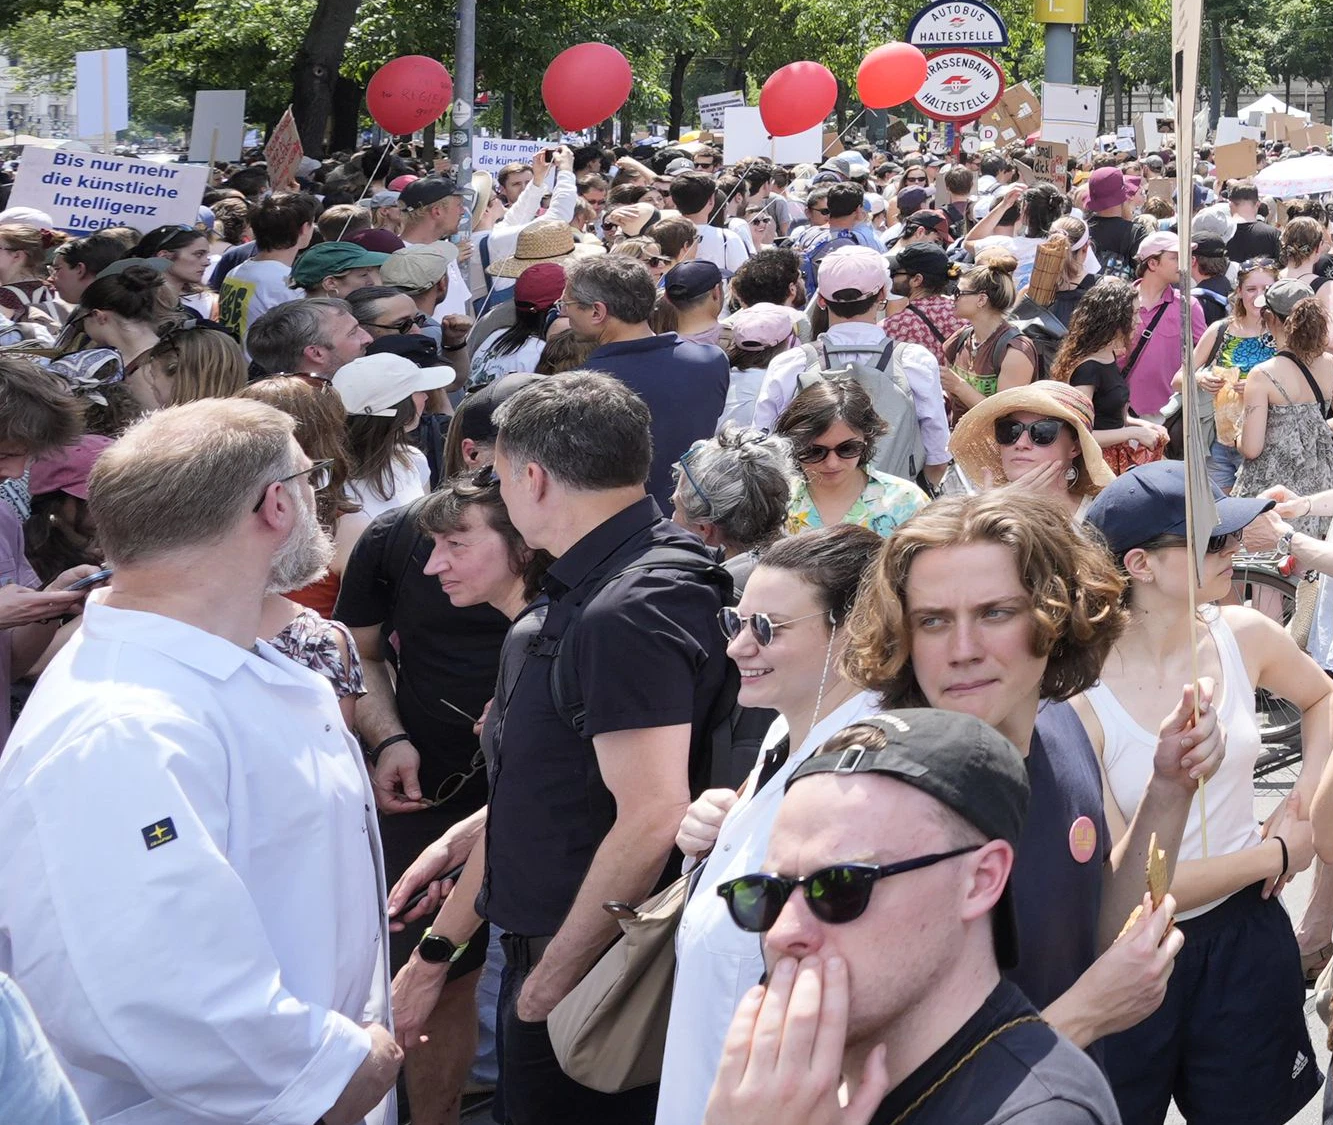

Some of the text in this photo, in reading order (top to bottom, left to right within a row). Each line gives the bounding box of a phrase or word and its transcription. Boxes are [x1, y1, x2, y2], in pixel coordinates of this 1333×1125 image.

[931, 5, 986, 22] AUTOBUS
[920, 31, 994, 42] HALTESTELLE
[925, 58, 994, 81] TRASSENBAHN
[922, 91, 990, 112] HALTESTELLE
[985, 130, 993, 138] D
[483, 141, 498, 151] Bis
[501, 143, 516, 151] nur
[53, 152, 178, 179] Bis nur mehr
[479, 155, 533, 165] die küntlic
[42, 172, 178, 199] die künstliche
[53, 193, 157, 217] Intelligenz
[69, 214, 126, 230] bleibt
